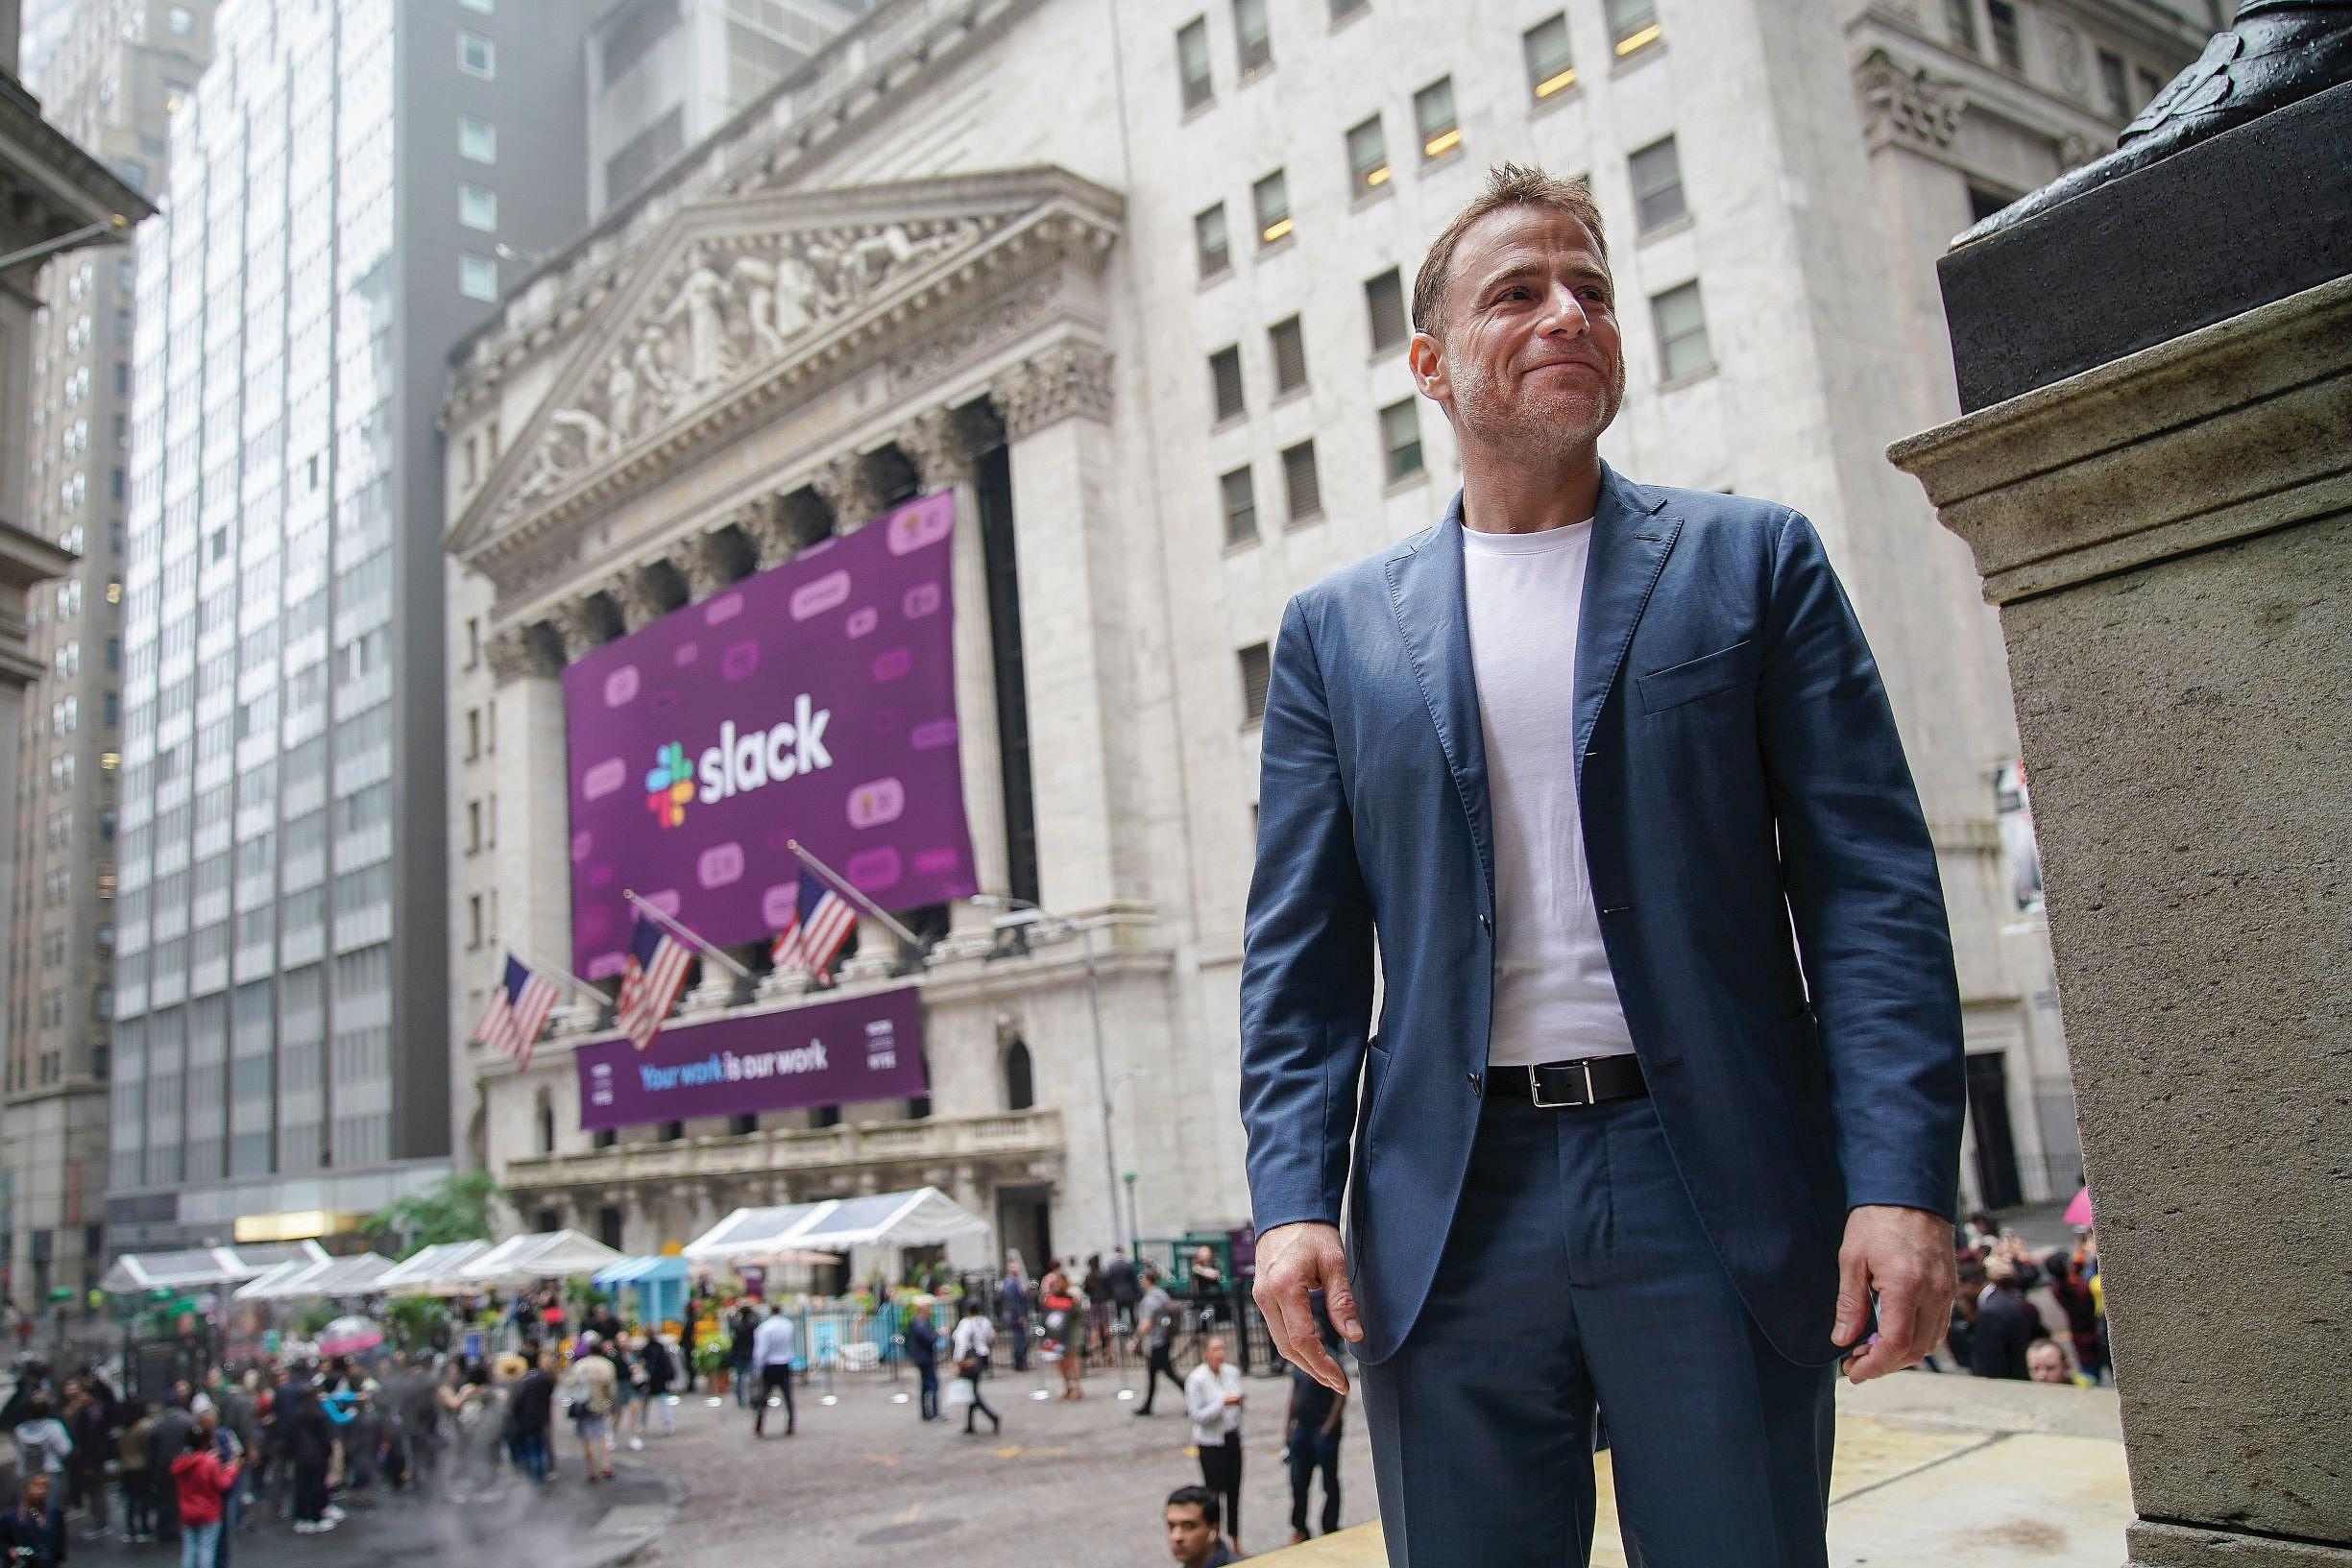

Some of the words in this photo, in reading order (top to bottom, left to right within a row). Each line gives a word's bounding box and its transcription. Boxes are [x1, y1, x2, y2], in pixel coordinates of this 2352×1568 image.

[698, 693, 833, 804] slack
[639, 1063, 678, 1091] Your
[679, 1052, 722, 1086] work
[722, 1050, 741, 1081] is
[742, 1051, 775, 1079] our
[775, 1038, 829, 1075] work
